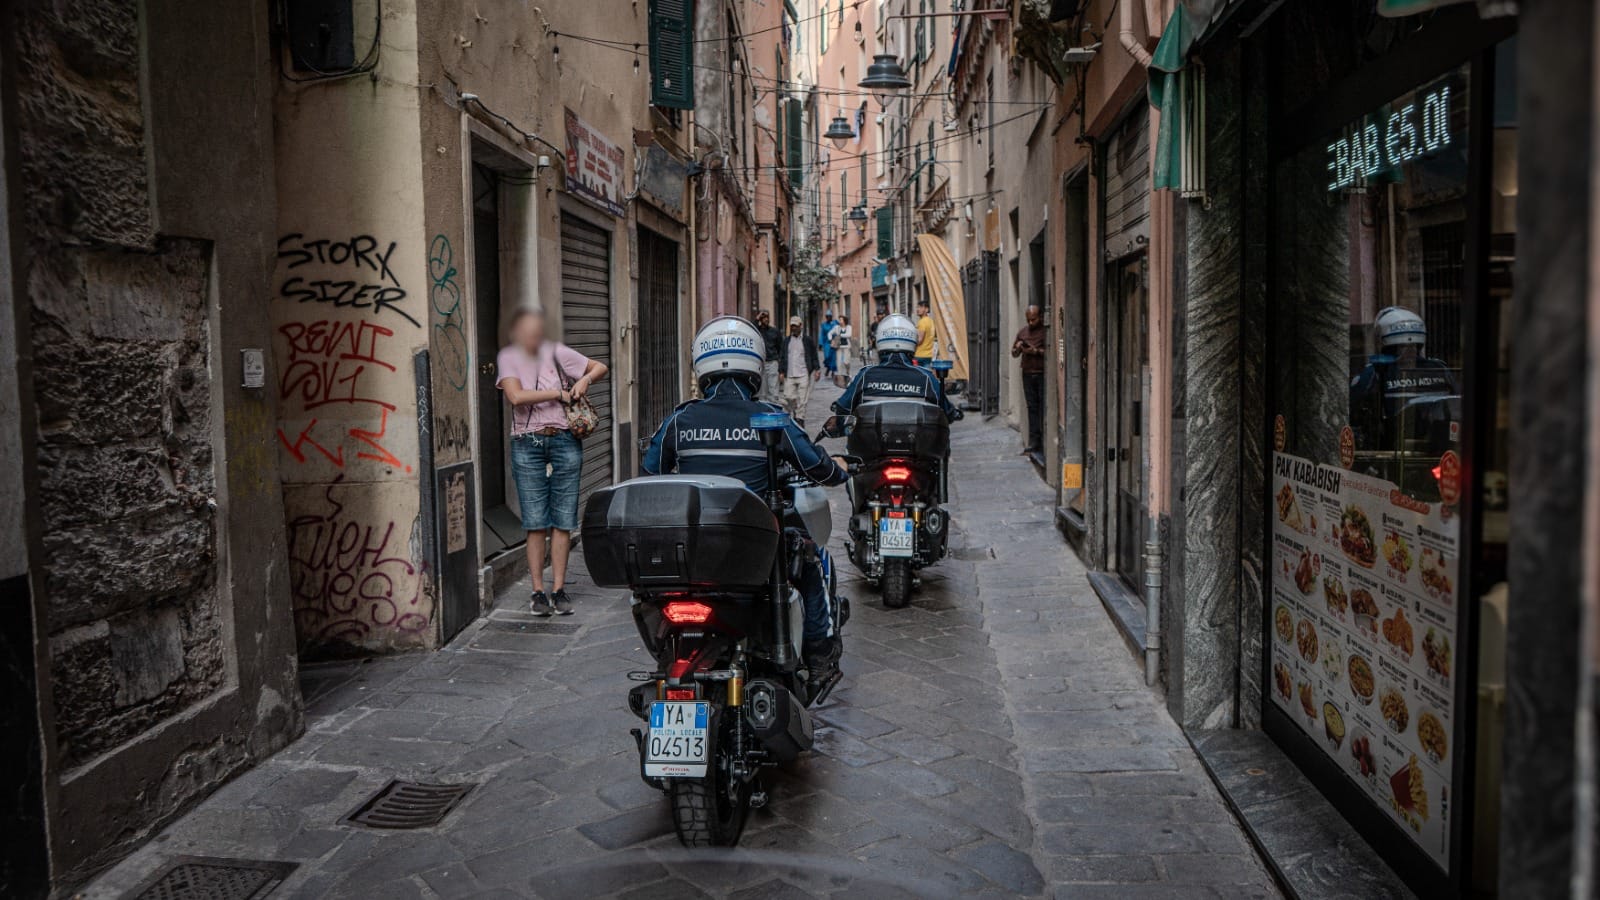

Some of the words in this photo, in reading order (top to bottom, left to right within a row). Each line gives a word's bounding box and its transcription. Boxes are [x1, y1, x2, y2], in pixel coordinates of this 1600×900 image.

[280, 276, 421, 329] SIZER
[700, 338, 726, 350] POLIZIA
[726, 337, 754, 349] LOCALE
[867, 382, 892, 391] POLIZIA
[894, 383, 921, 394] LOCALE
[679, 428, 721, 442] POLIZIA
[725, 428, 760, 441] LOCA
[1275, 456, 1292, 479] PAK
[1293, 461, 1342, 495] KABABISH
[889, 520, 900, 530] YA
[882, 535, 911, 547] 04512
[665, 704, 684, 725] YA
[651, 737, 704, 757] 04513
